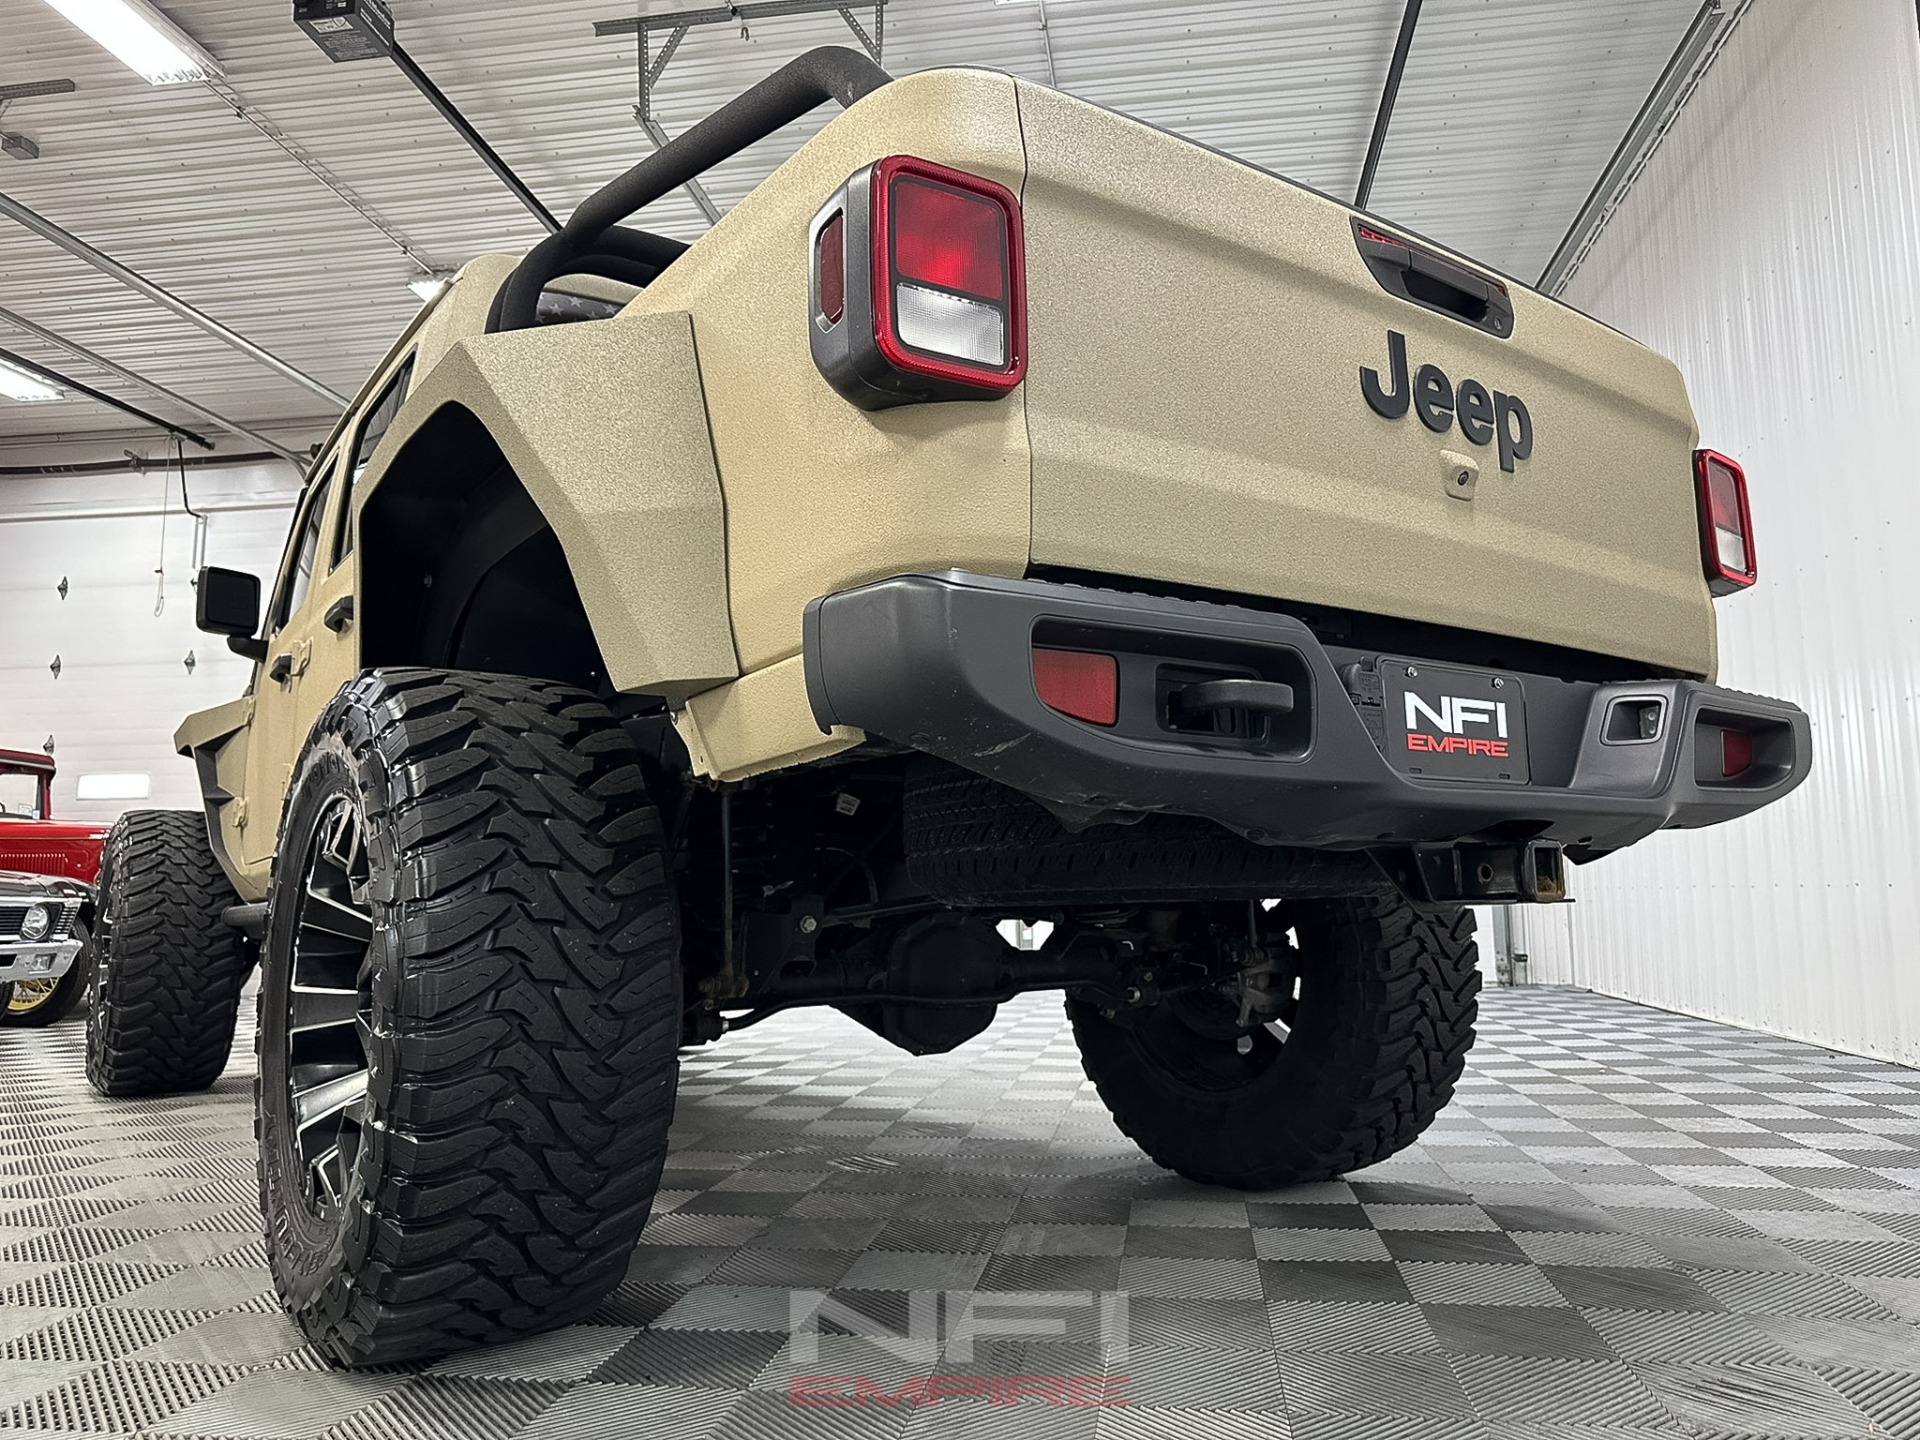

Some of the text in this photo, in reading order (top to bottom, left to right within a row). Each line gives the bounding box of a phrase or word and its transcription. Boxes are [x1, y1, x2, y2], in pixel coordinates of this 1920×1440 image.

[1360, 330, 1533, 473] Jeep
[1404, 691, 1508, 738] NFI
[1407, 733, 1509, 757] EMPIRE
